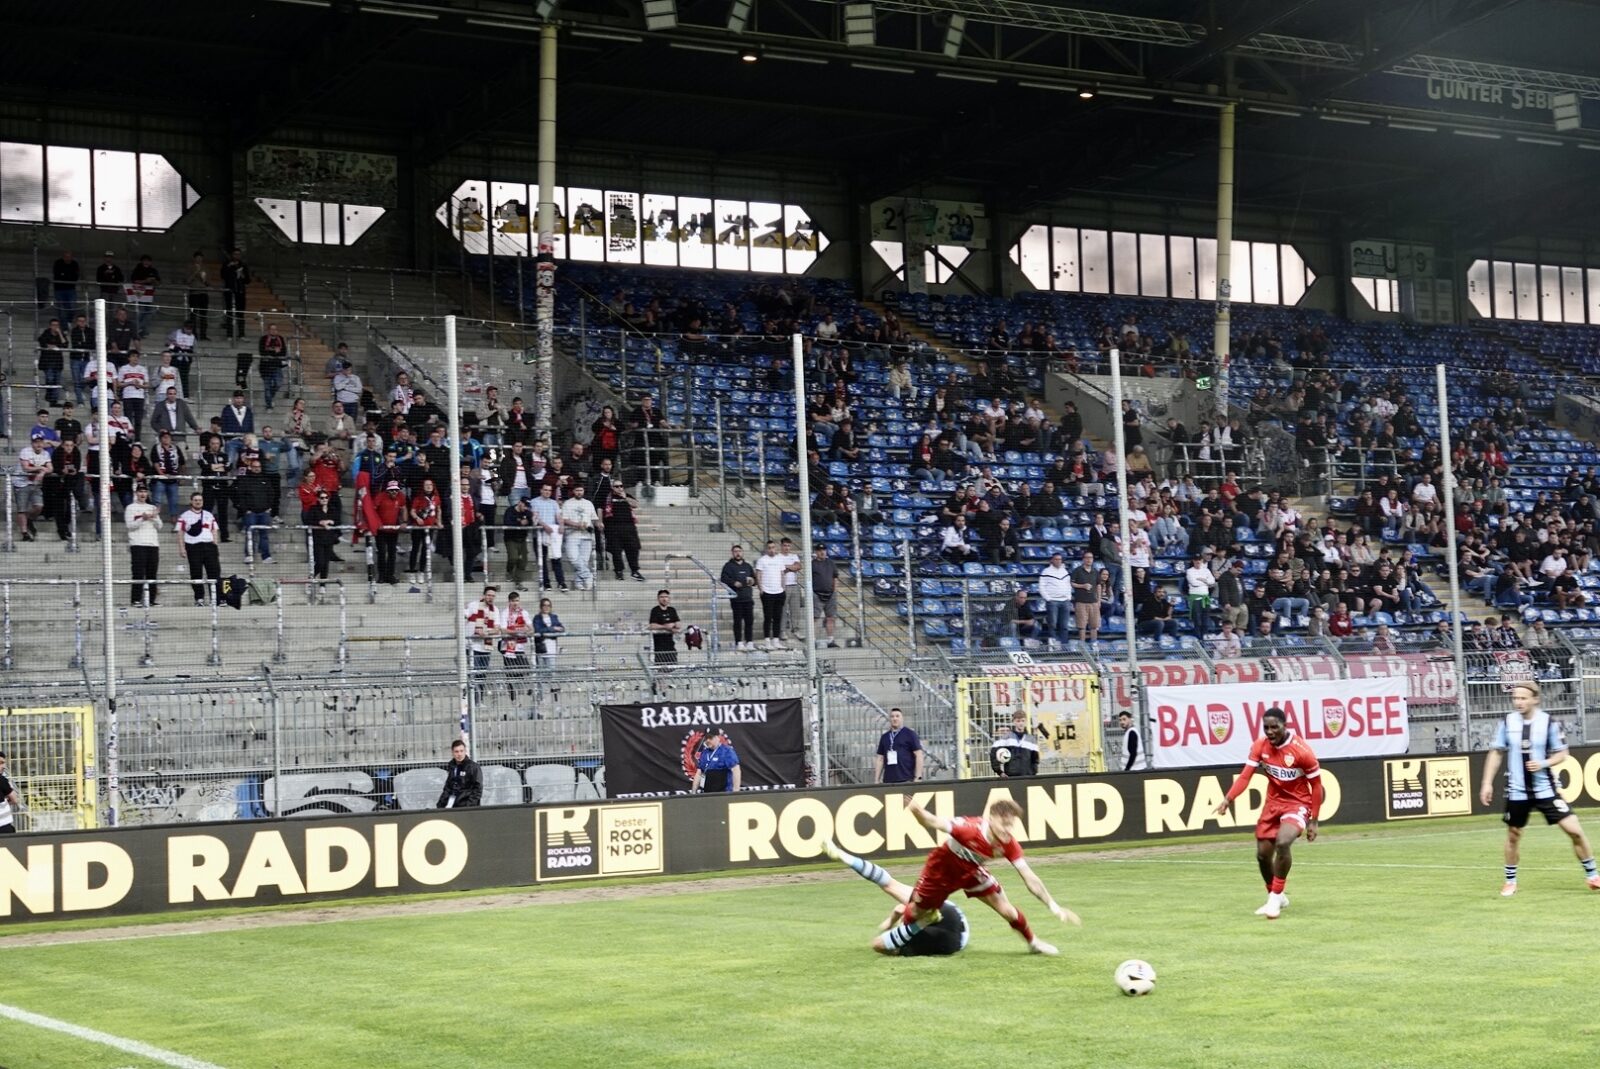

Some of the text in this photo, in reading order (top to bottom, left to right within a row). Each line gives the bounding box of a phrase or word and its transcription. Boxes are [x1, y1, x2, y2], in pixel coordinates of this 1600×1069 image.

[1012, 653, 1031, 665] 26
[640, 703, 768, 728] RABAUKEN
[1157, 696, 1404, 747] BAD WALDSEE
[1434, 777, 1464, 789] ROCK
[1143, 768, 1342, 833] RADO
[1392, 791, 1423, 799] ROCKLAND
[1443, 789, 1465, 800] POP
[1393, 799, 1424, 810] RADIO
[614, 818, 648, 828] bester
[610, 828, 653, 843] ROCK
[547, 846, 592, 856] ROCKLAND
[624, 843, 653, 856] POP
[168, 819, 469, 904] RADIO
[547, 854, 593, 868] RADIO
